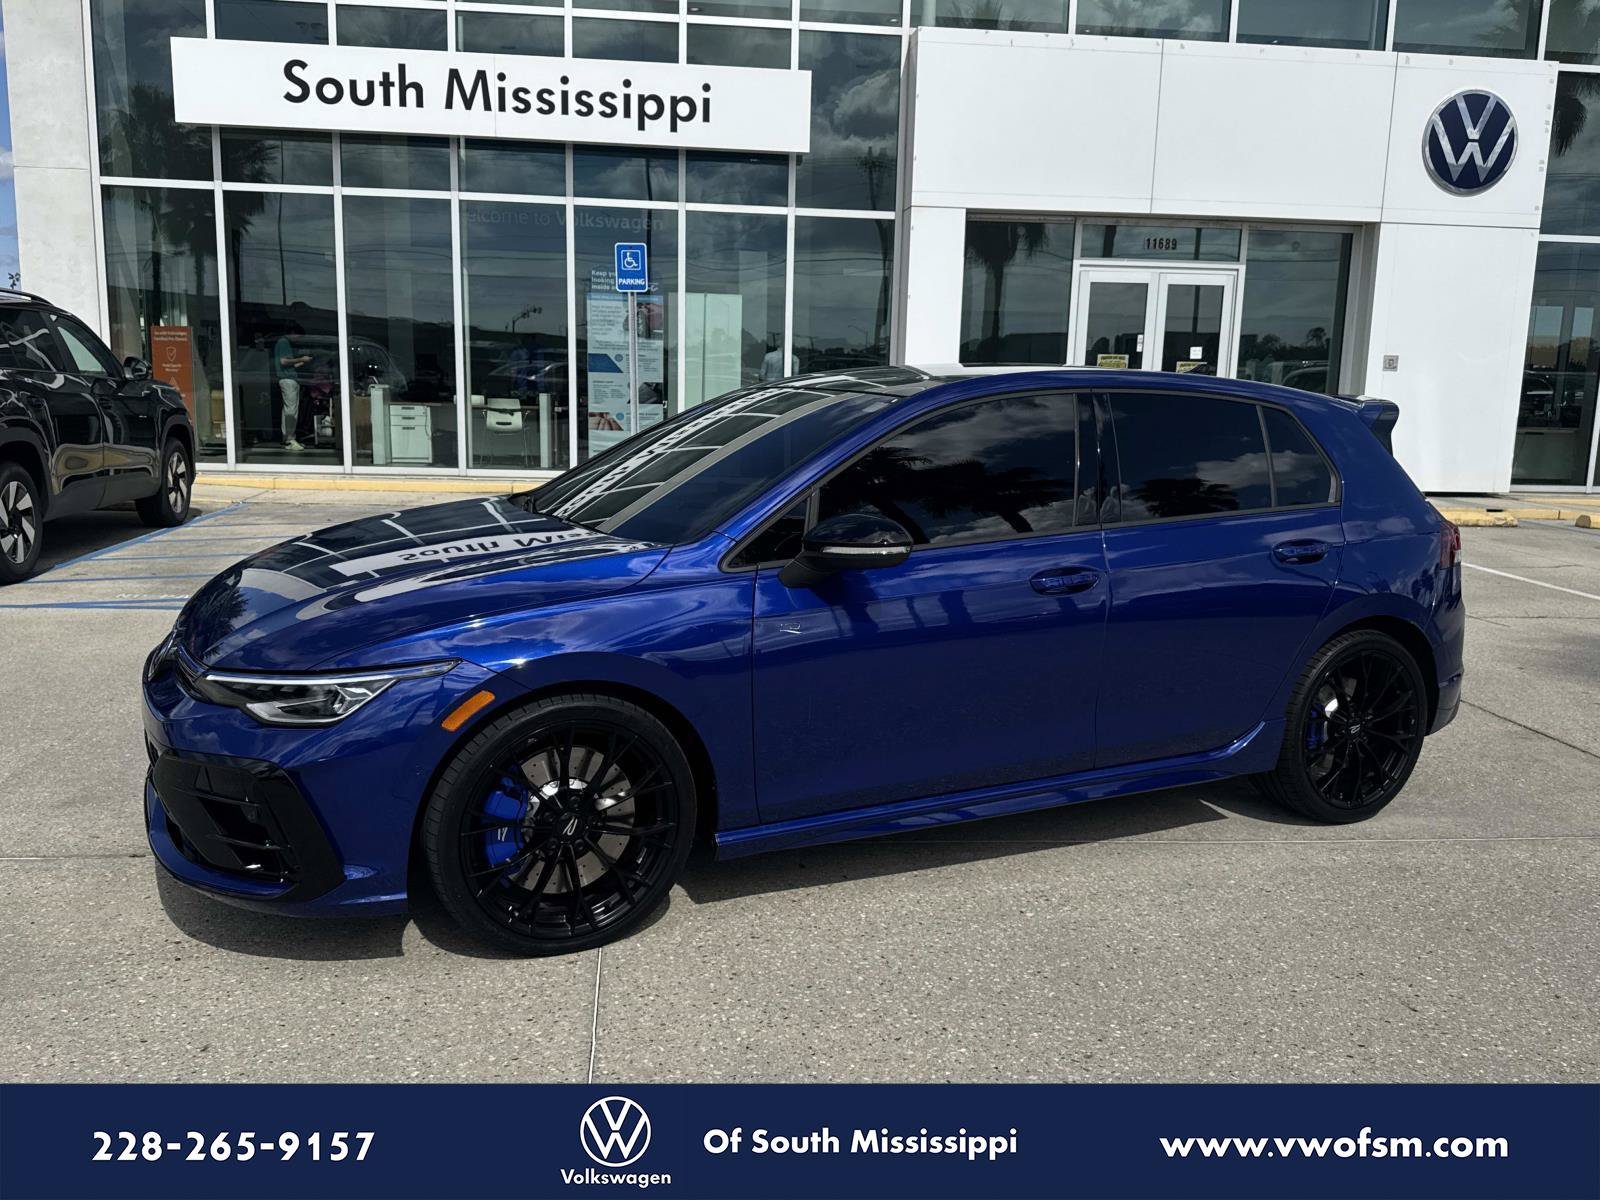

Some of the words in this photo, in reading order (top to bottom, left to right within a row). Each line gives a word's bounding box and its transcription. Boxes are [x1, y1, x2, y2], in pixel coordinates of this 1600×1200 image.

[283, 59, 424, 109] South
[444, 67, 712, 132] Mississippi
[465, 207, 529, 225] elcome
[1146, 237, 1178, 250] 11689
[618, 278, 645, 286] PARKING
